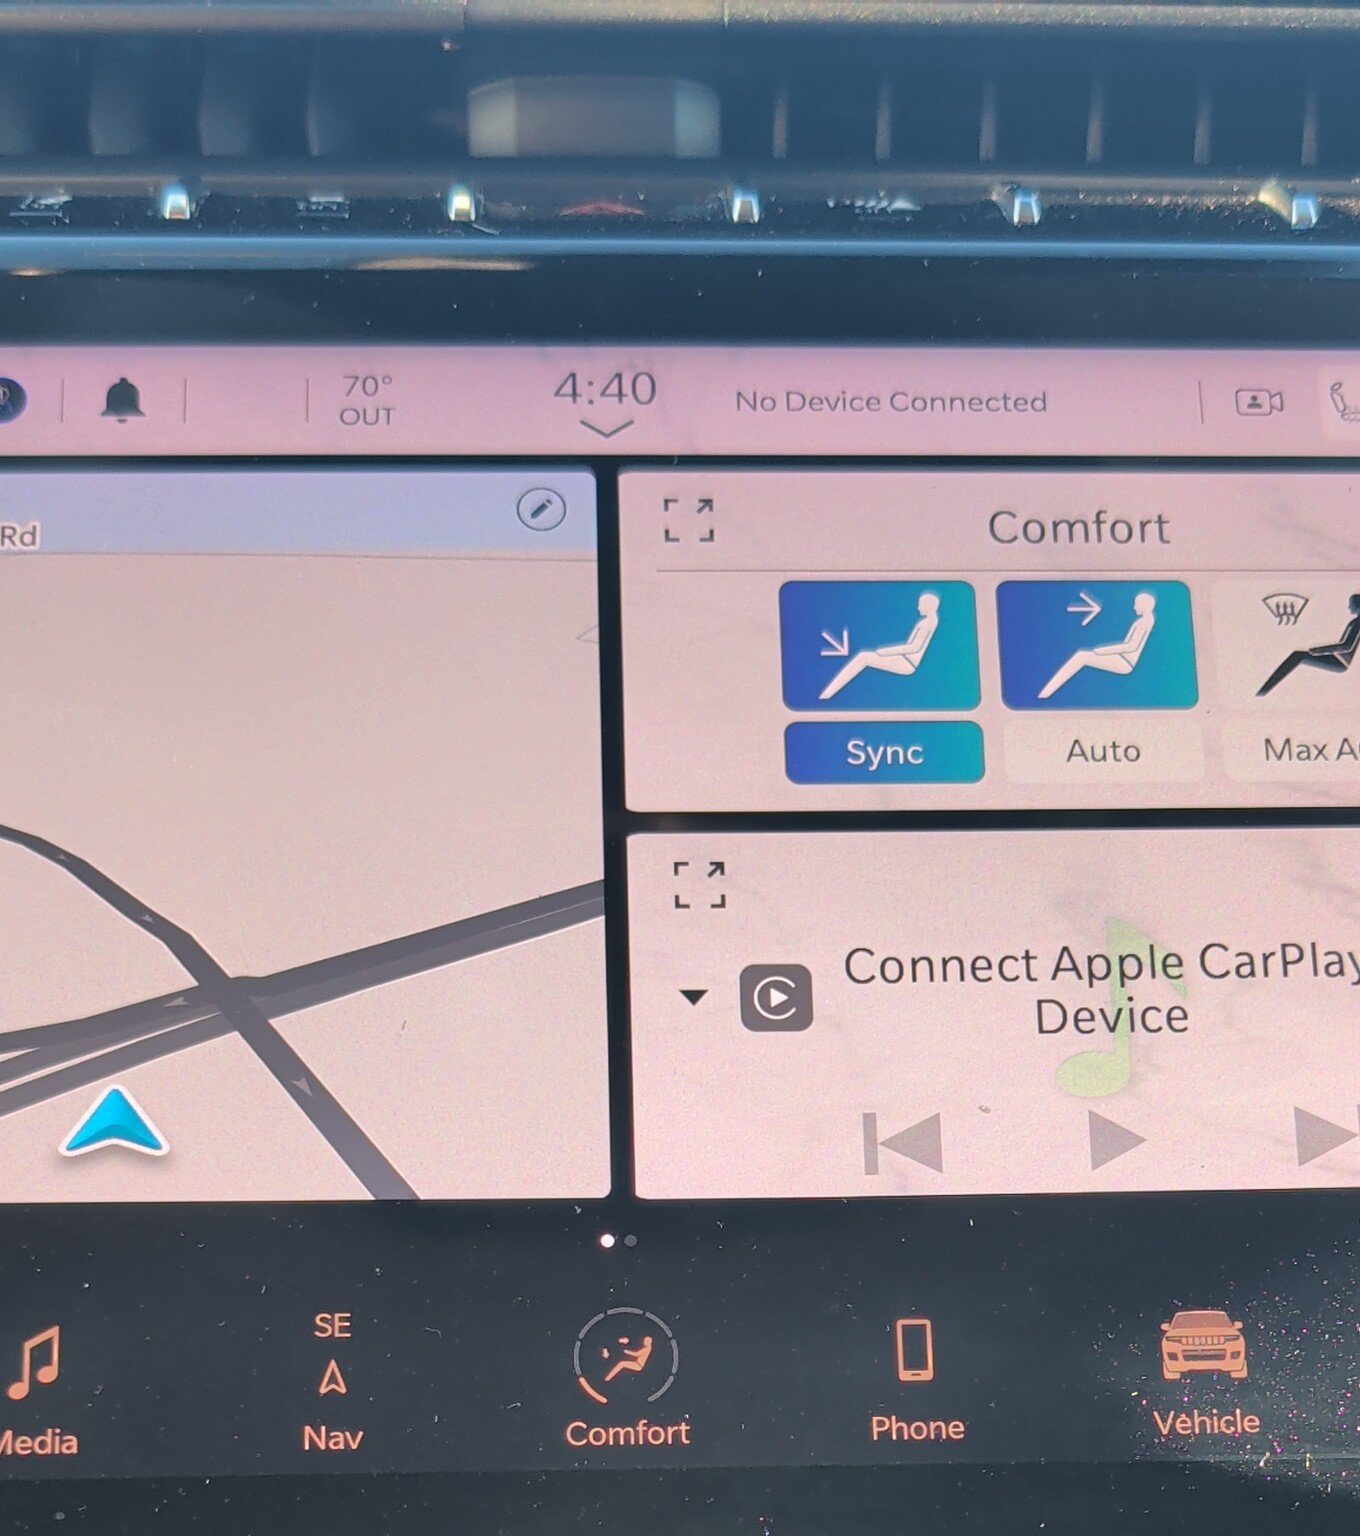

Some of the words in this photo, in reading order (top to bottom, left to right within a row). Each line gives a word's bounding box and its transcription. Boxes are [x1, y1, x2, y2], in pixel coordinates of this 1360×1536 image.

[342, 375, 394, 398] 70°
[553, 371, 657, 405] 4:40
[736, 391, 777, 413] No
[785, 390, 882, 413] Device
[889, 390, 1048, 413] Connected
[339, 407, 395, 427] OUT
[0, 525, 38, 548] Rd
[989, 509, 1171, 545] Comfort
[846, 739, 924, 771] Sync
[1066, 737, 1142, 764] Auto
[1263, 737, 1330, 763] Max
[844, 946, 1038, 985] Connect
[1051, 943, 1184, 988] Apple
[1036, 995, 1189, 1034] Device
[313, 1312, 352, 1339] SE
[565, 1420, 691, 1447] Comfort
[871, 1415, 966, 1442] Phone
[1153, 1409, 1261, 1437] Vehicle
[302, 1425, 364, 1452] Nav
